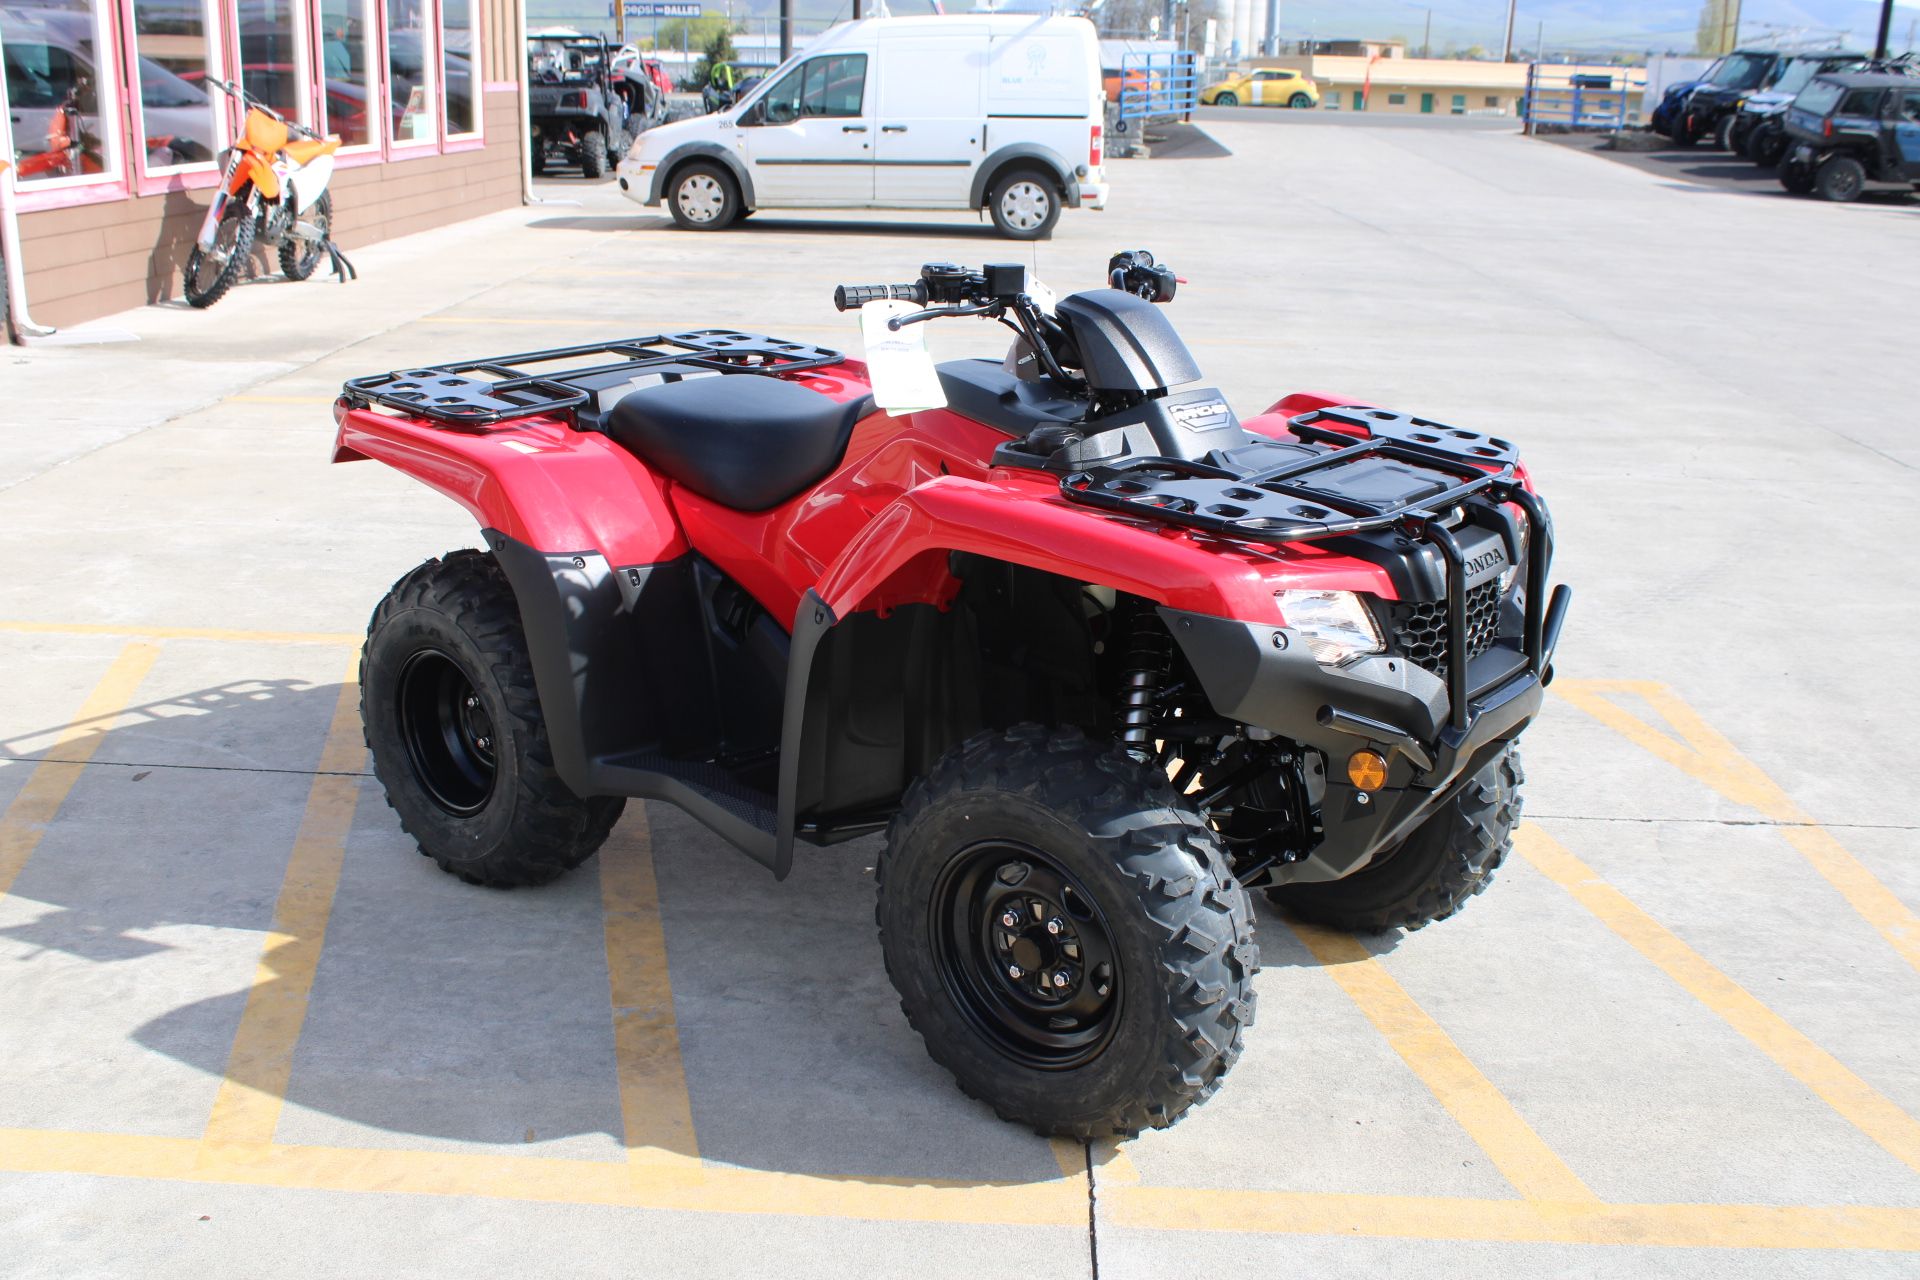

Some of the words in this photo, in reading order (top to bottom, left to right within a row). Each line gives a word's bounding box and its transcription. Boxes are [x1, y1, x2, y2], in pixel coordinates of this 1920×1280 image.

[664, 5, 700, 16] DALLES
[718, 119, 734, 129] 265
[1464, 548, 1504, 578] ONDA
